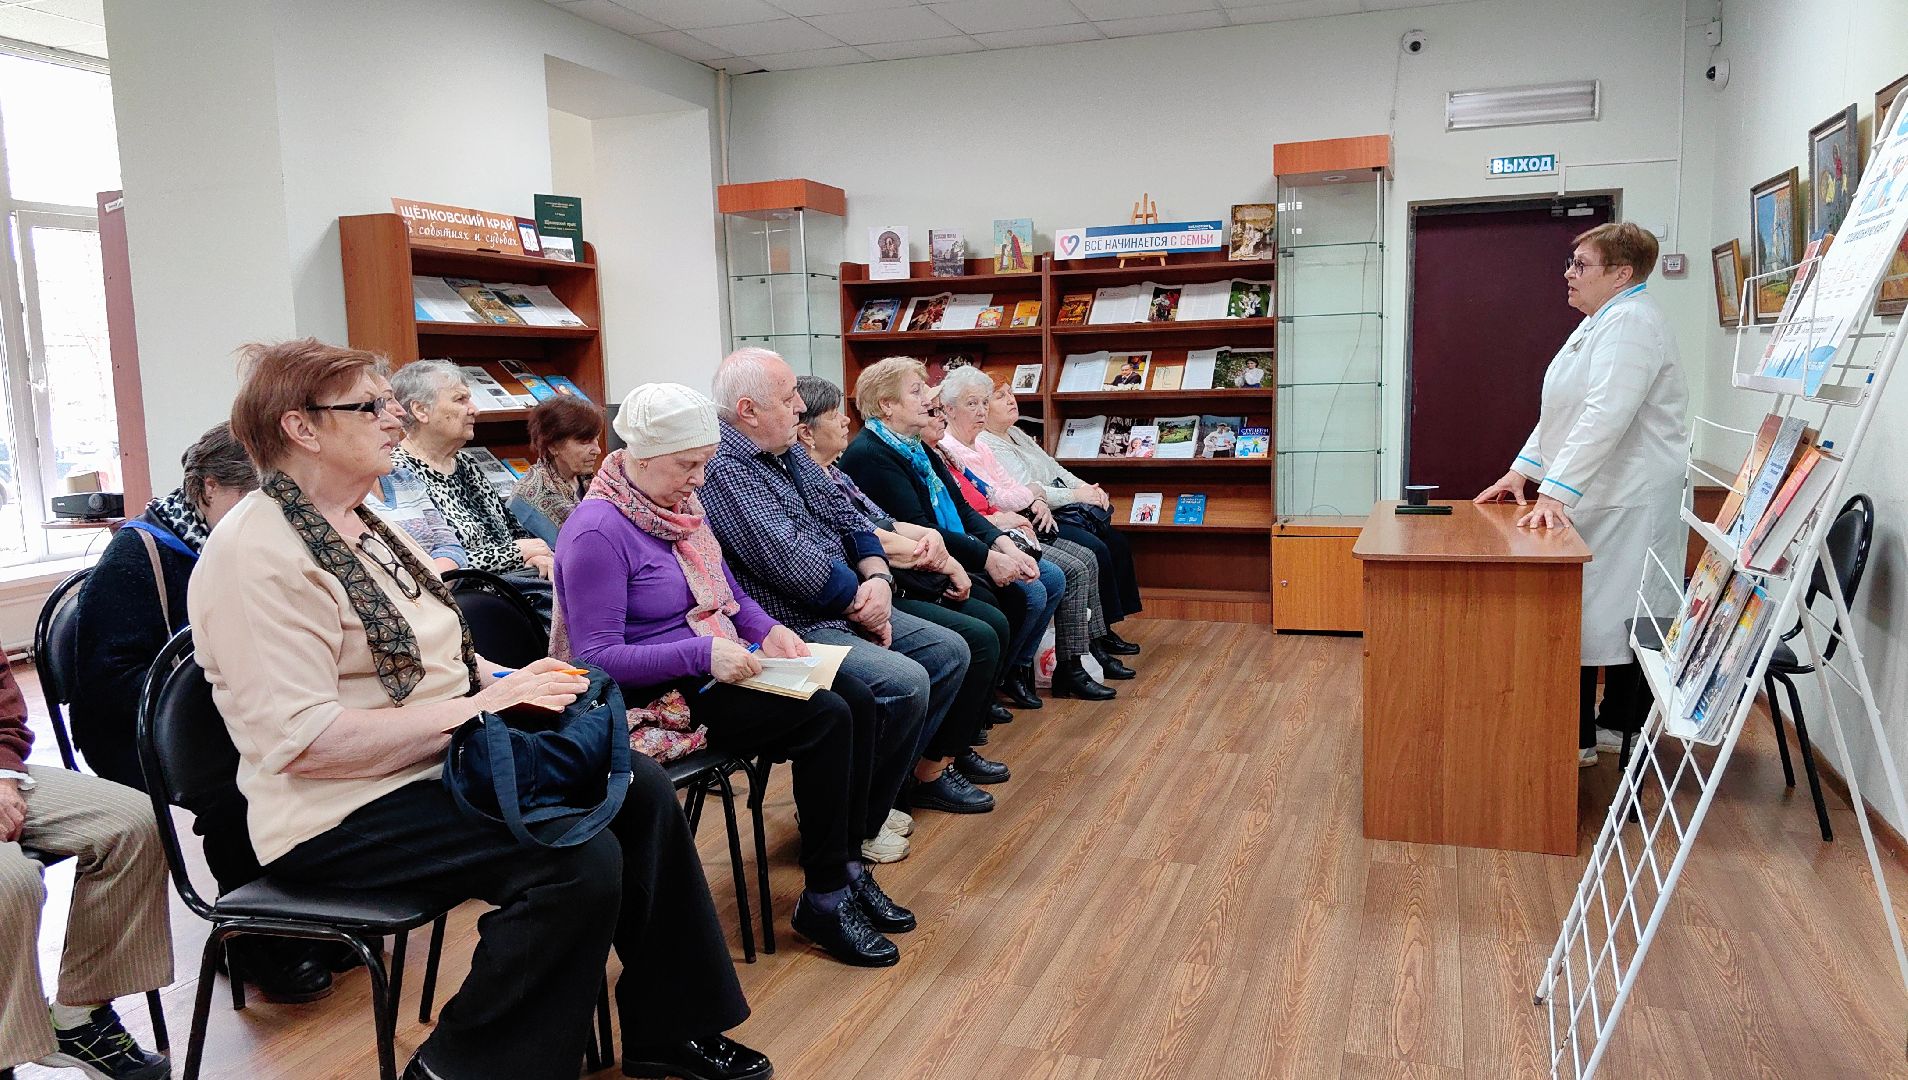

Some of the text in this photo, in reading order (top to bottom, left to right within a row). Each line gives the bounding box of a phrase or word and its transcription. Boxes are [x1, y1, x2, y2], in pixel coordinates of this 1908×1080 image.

[1493, 157, 1552, 174] ВЫХОД
[400, 204, 515, 231] ЩЁЛКОВСКИЙ КРАЙ
[419, 221, 470, 240] событиях
[486, 231, 518, 248] судьбах
[1105, 236, 1168, 250] НАЧИНАЕТСЯ
[1170, 235, 1177, 245] С
[1180, 233, 1214, 245] СЕМЬИ
